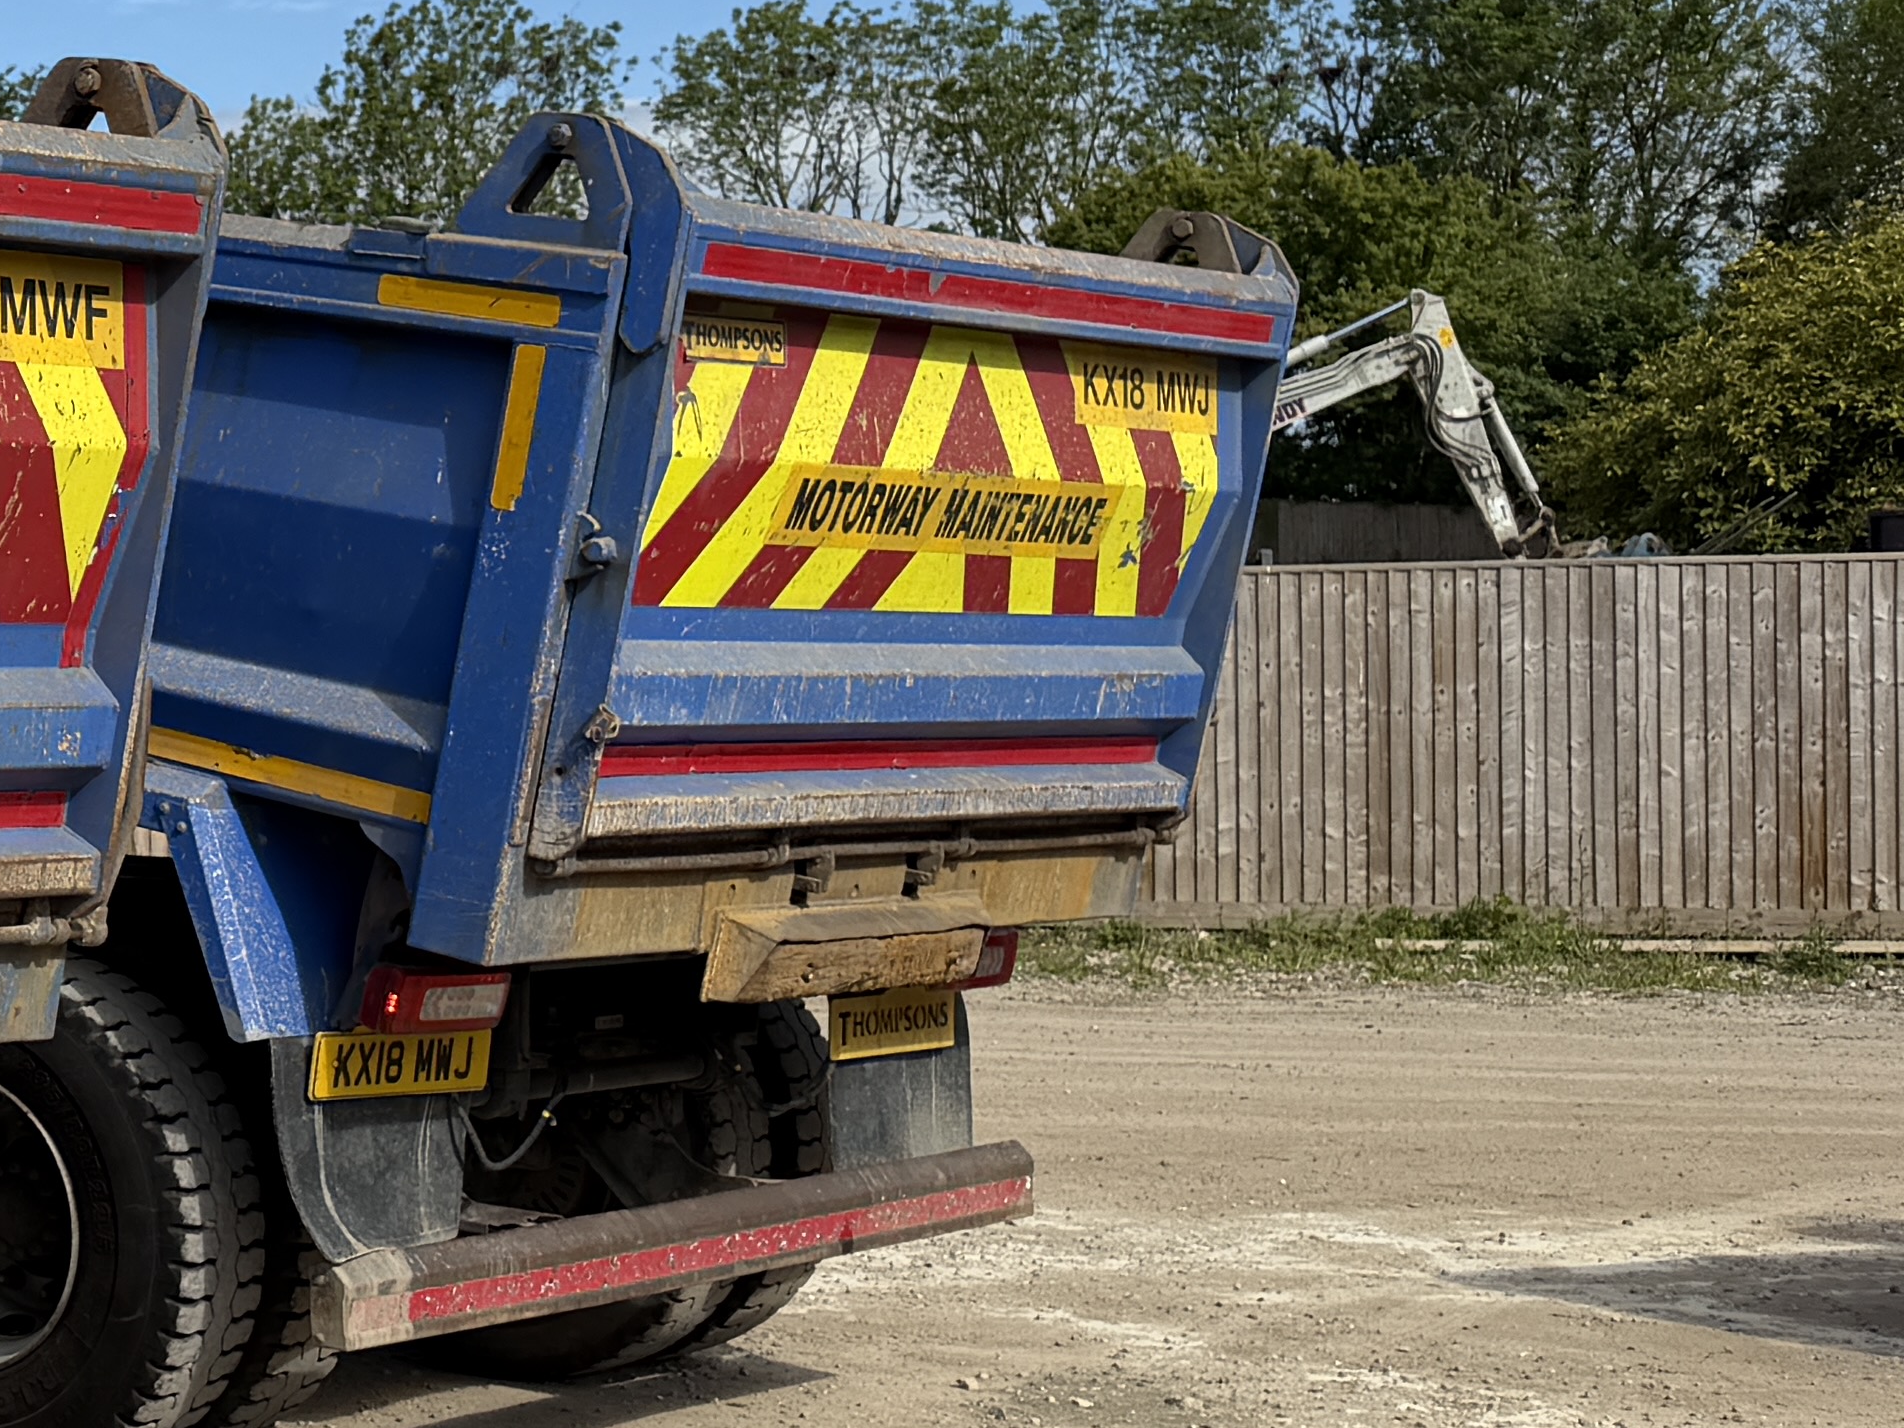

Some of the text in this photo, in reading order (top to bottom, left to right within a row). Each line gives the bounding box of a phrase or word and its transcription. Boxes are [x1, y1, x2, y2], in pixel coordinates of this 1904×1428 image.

[683, 322, 783, 353] THOMPSONS
[1082, 359, 1211, 416] KX18 MWJ
[785, 478, 1106, 545] MOTORWAY MAINTENANCE
[838, 1001, 949, 1046] THOMPSONS
[332, 1036, 474, 1088] KX18 MWJ
